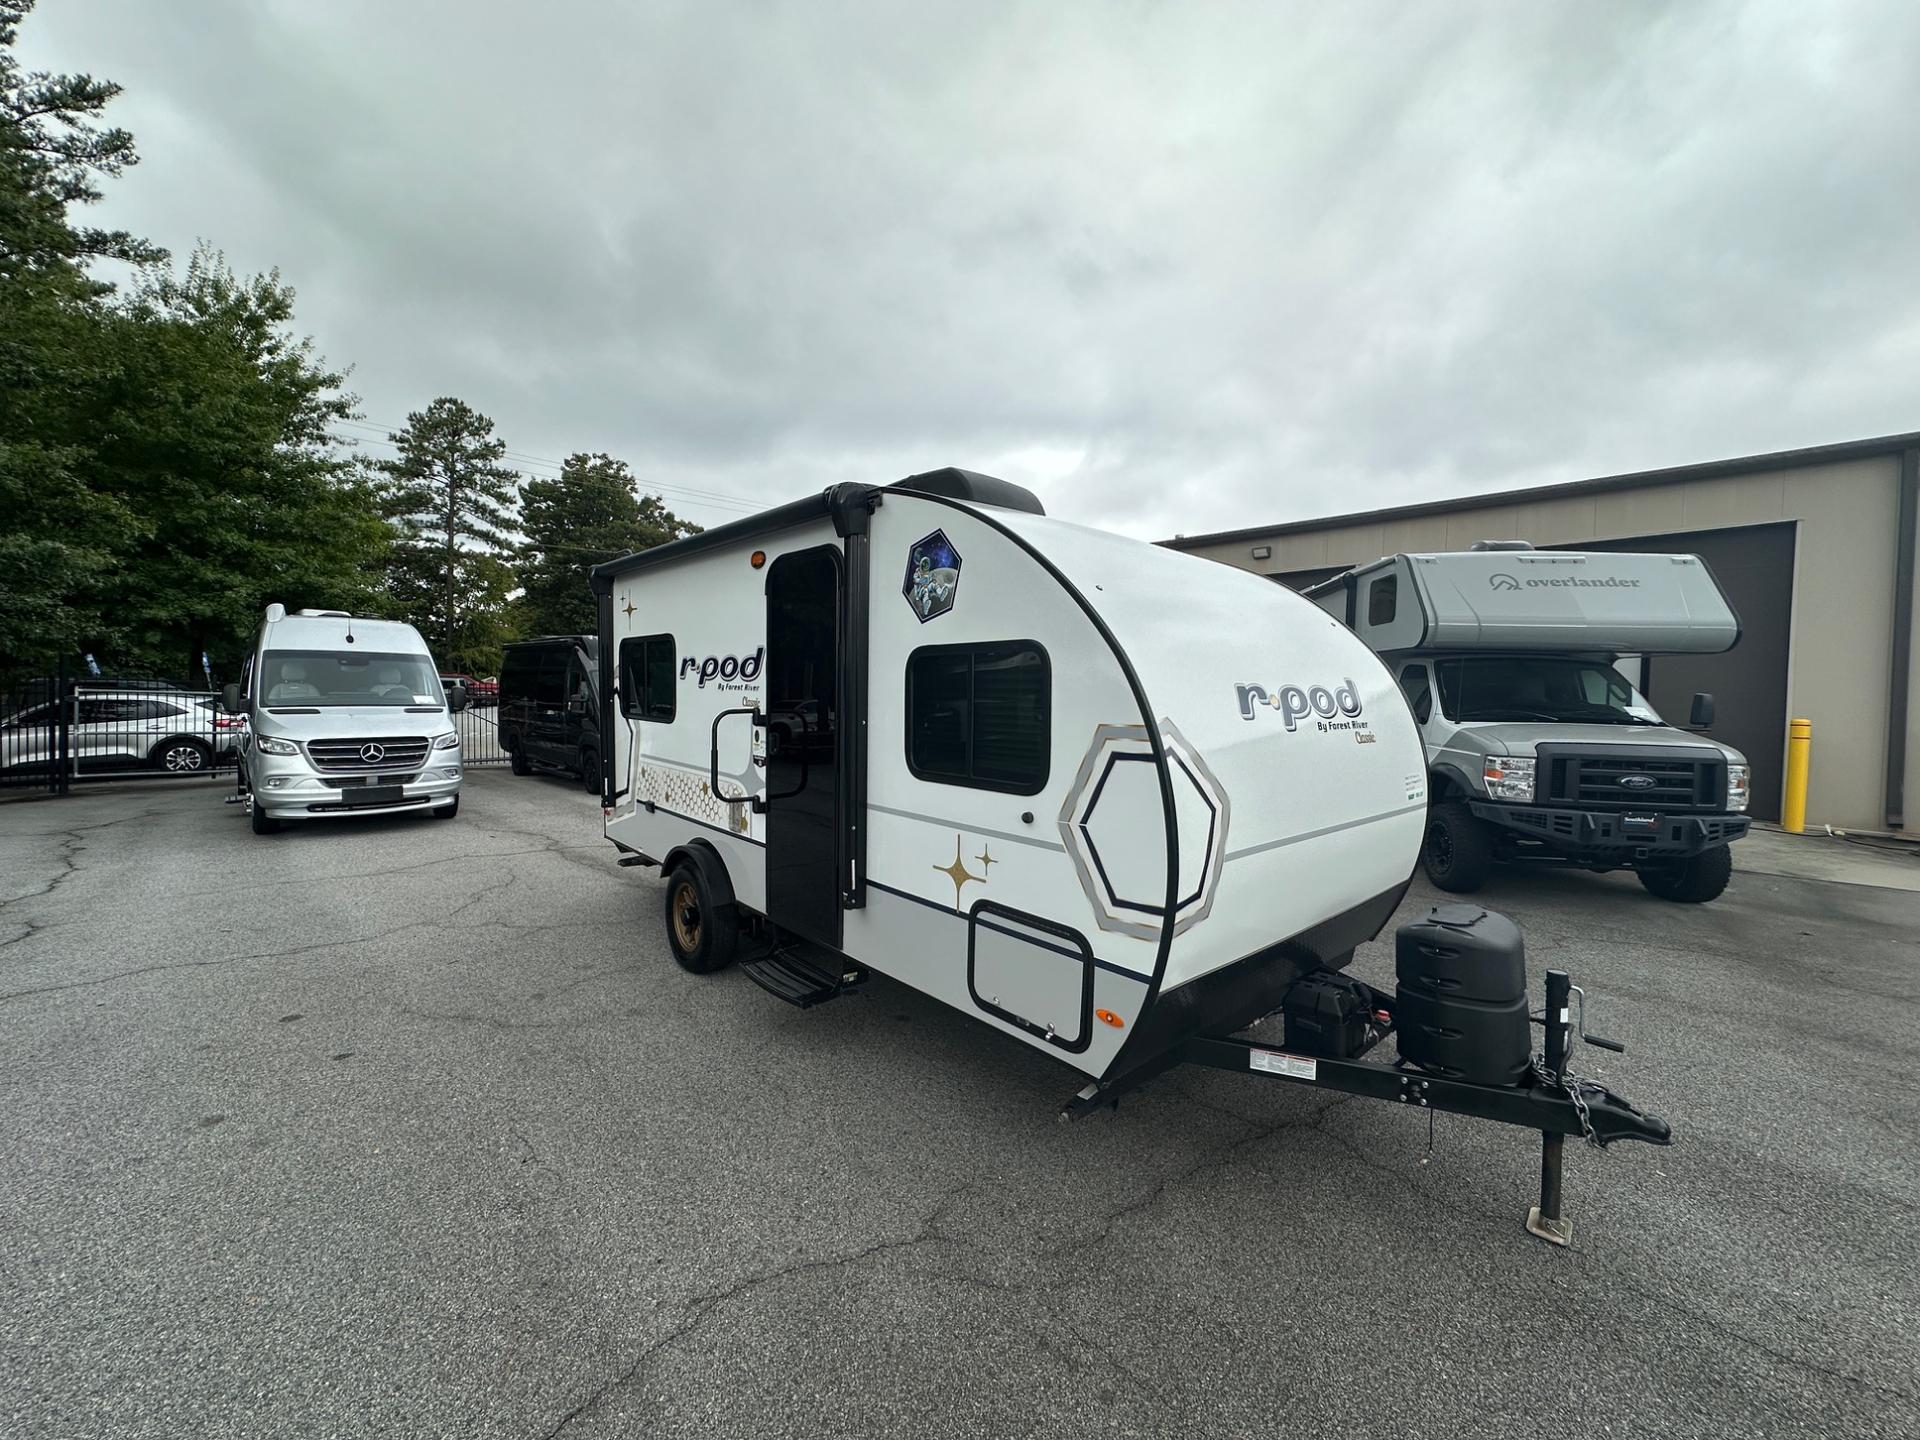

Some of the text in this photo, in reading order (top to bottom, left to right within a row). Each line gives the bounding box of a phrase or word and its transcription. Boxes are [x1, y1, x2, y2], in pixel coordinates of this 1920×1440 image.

[1526, 576, 1640, 588] overlander
[1317, 720, 1368, 733] By Forest River
